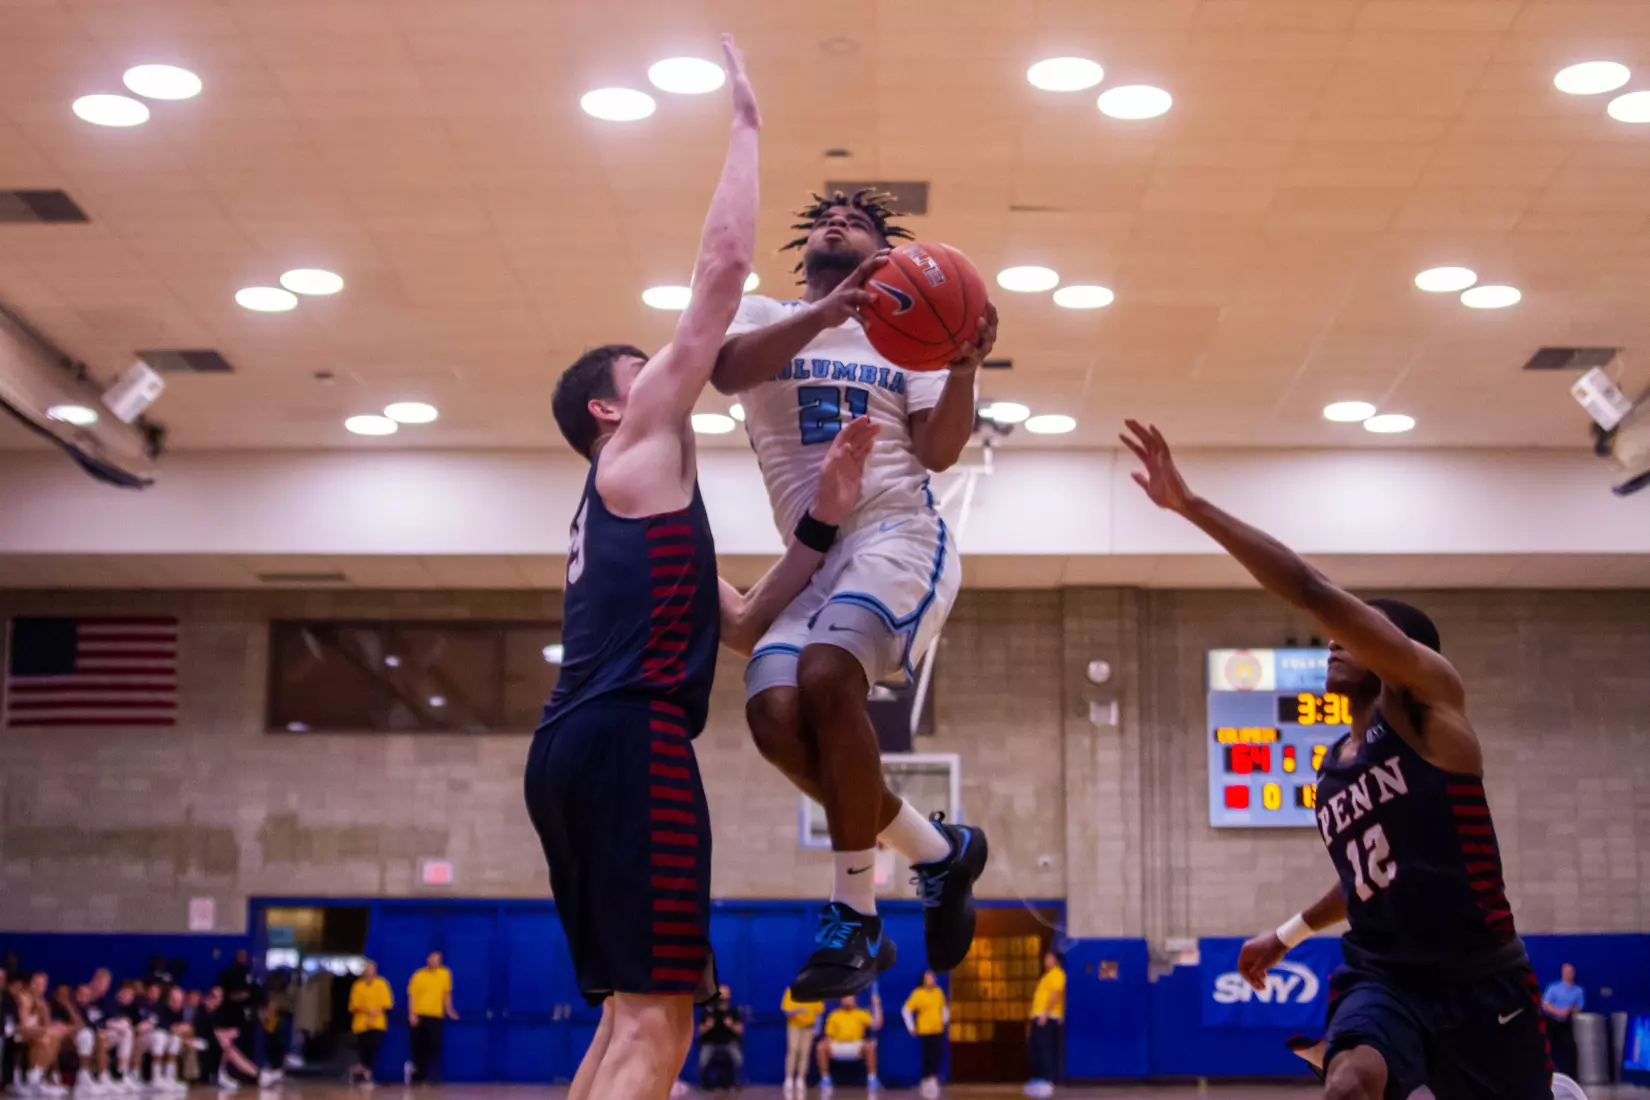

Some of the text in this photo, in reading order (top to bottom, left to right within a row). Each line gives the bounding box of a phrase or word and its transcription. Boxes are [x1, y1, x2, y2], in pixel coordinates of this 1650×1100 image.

[777, 358, 905, 394] LUMBIA
[1318, 755, 1409, 848] PENN
[1346, 822, 1398, 903] 12
[1213, 971, 1301, 1004] SNY
